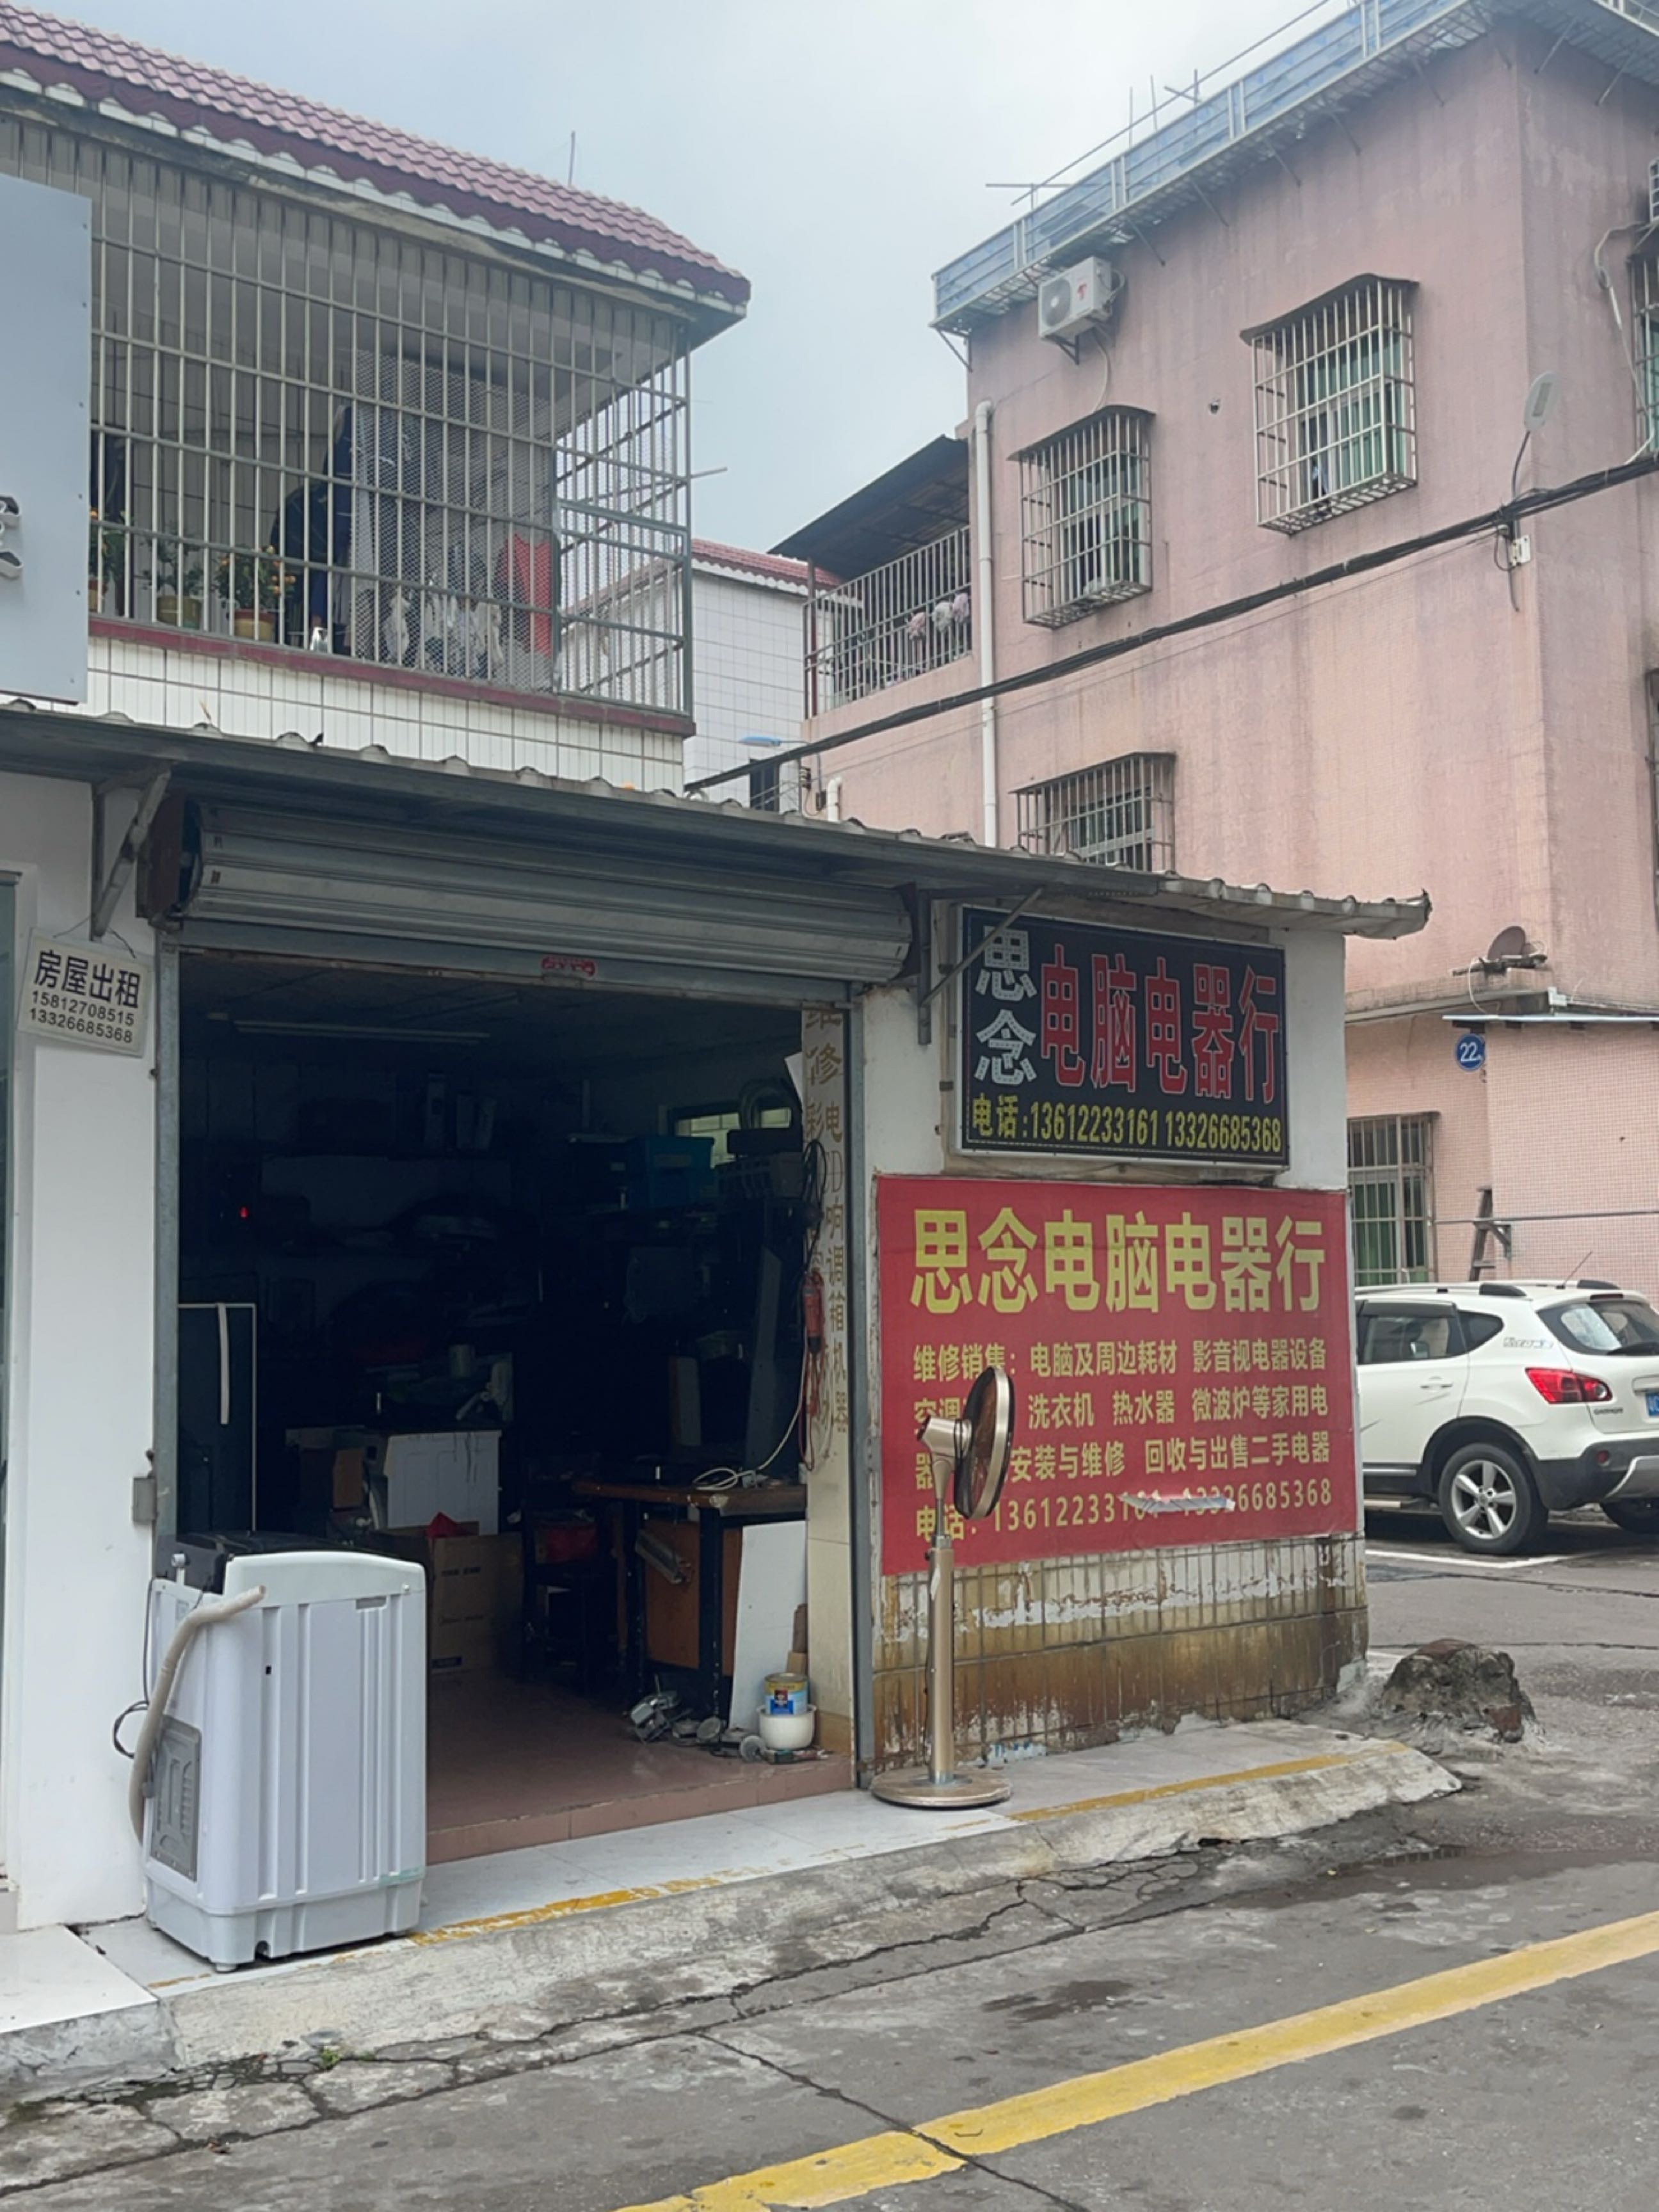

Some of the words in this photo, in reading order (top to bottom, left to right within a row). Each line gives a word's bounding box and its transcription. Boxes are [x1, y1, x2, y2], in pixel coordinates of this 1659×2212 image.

[34, 949, 140, 1009] 房屋出租
[30, 1008, 133, 1043] 13326685368
[32, 990, 134, 1027] 15812708515
[975, 926, 1037, 1085] 思念
[1041, 943, 1279, 1105] 电脑电器行
[1166, 1111, 1281, 1153] 13326685368
[911, 1208, 1326, 1314] 思念电脑电器行
[1030, 1340, 1177, 1377] 电脑及周边耗材
[1193, 1337, 1326, 1373] 影音视电器设备
[1029, 1391, 1094, 1429] 洗衣机
[1112, 1389, 1175, 1425] 热水器
[1192, 1384, 1328, 1423] 微波炉等家用电
[1010, 1440, 1126, 1482] 安装与维修
[1145, 1431, 1329, 1475] 回收与出售二手电器
